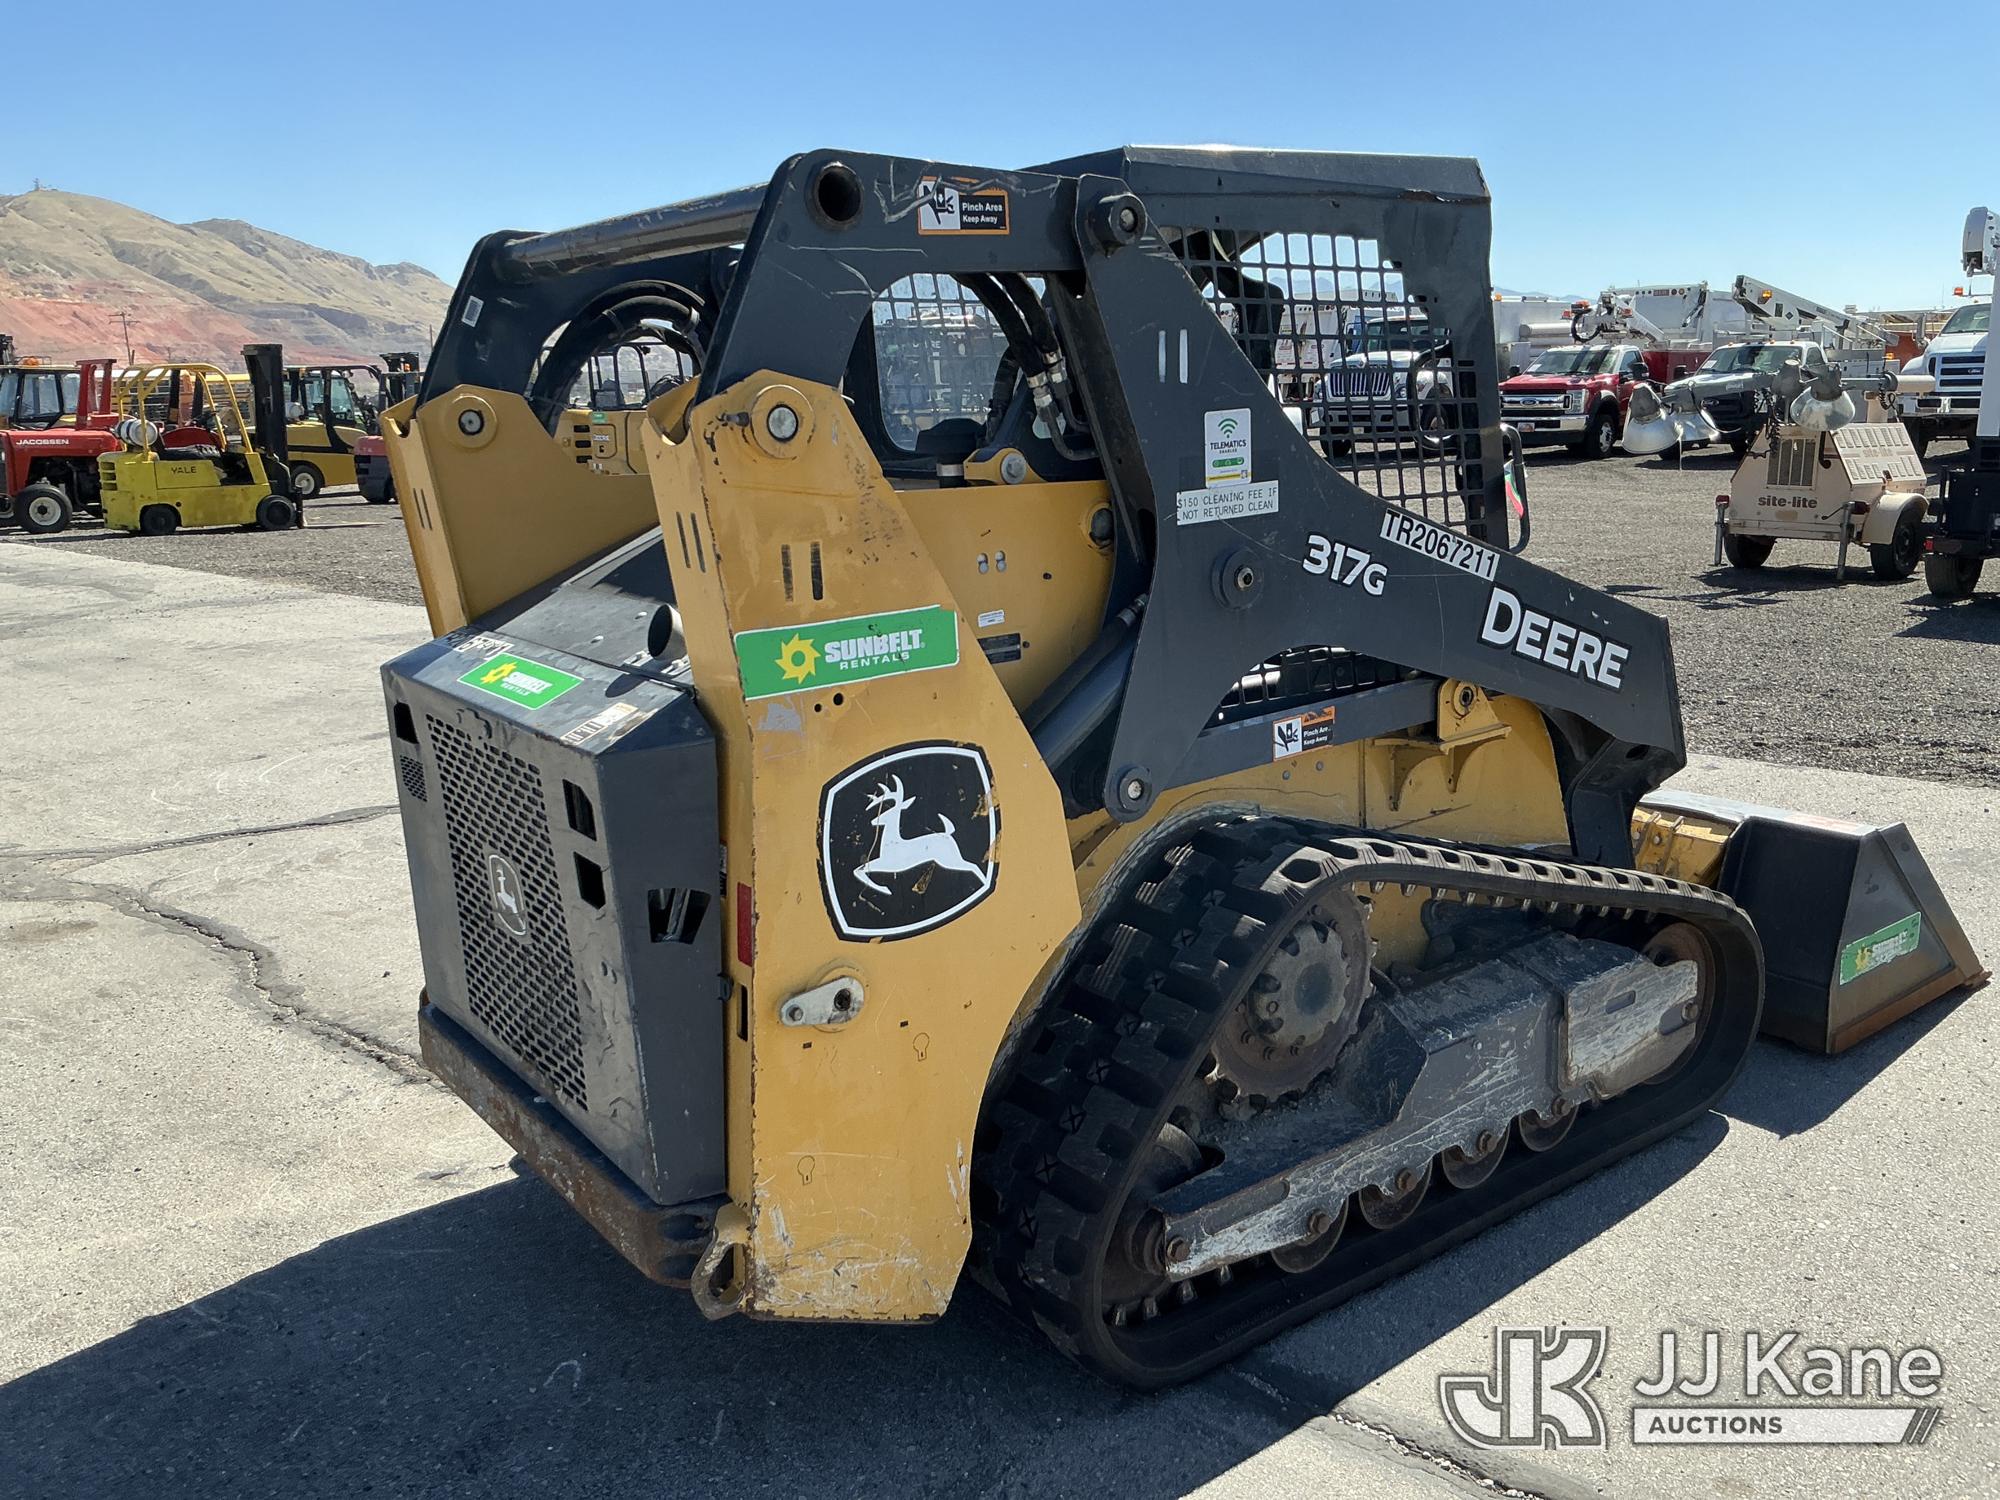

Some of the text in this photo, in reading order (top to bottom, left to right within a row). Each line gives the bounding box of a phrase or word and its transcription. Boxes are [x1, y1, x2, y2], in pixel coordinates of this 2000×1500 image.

[962, 202, 1003, 212] Pinch Area
[962, 215, 998, 225] Keep Away
[1210, 440, 1247, 450] TELEMATICS
[171, 466, 197, 474] YALE
[1177, 486, 1278, 509] $150 CLEANING FEE IF
[1758, 495, 1818, 509] site-lite
[1182, 500, 1274, 521] NOT RETURNED CLEAN
[1384, 510, 1497, 580] TR2067211
[1302, 534, 1388, 596] 317G
[824, 628, 924, 664] SUNBELT
[1481, 586, 1630, 690] DEERE
[839, 650, 911, 671] RENTALS
